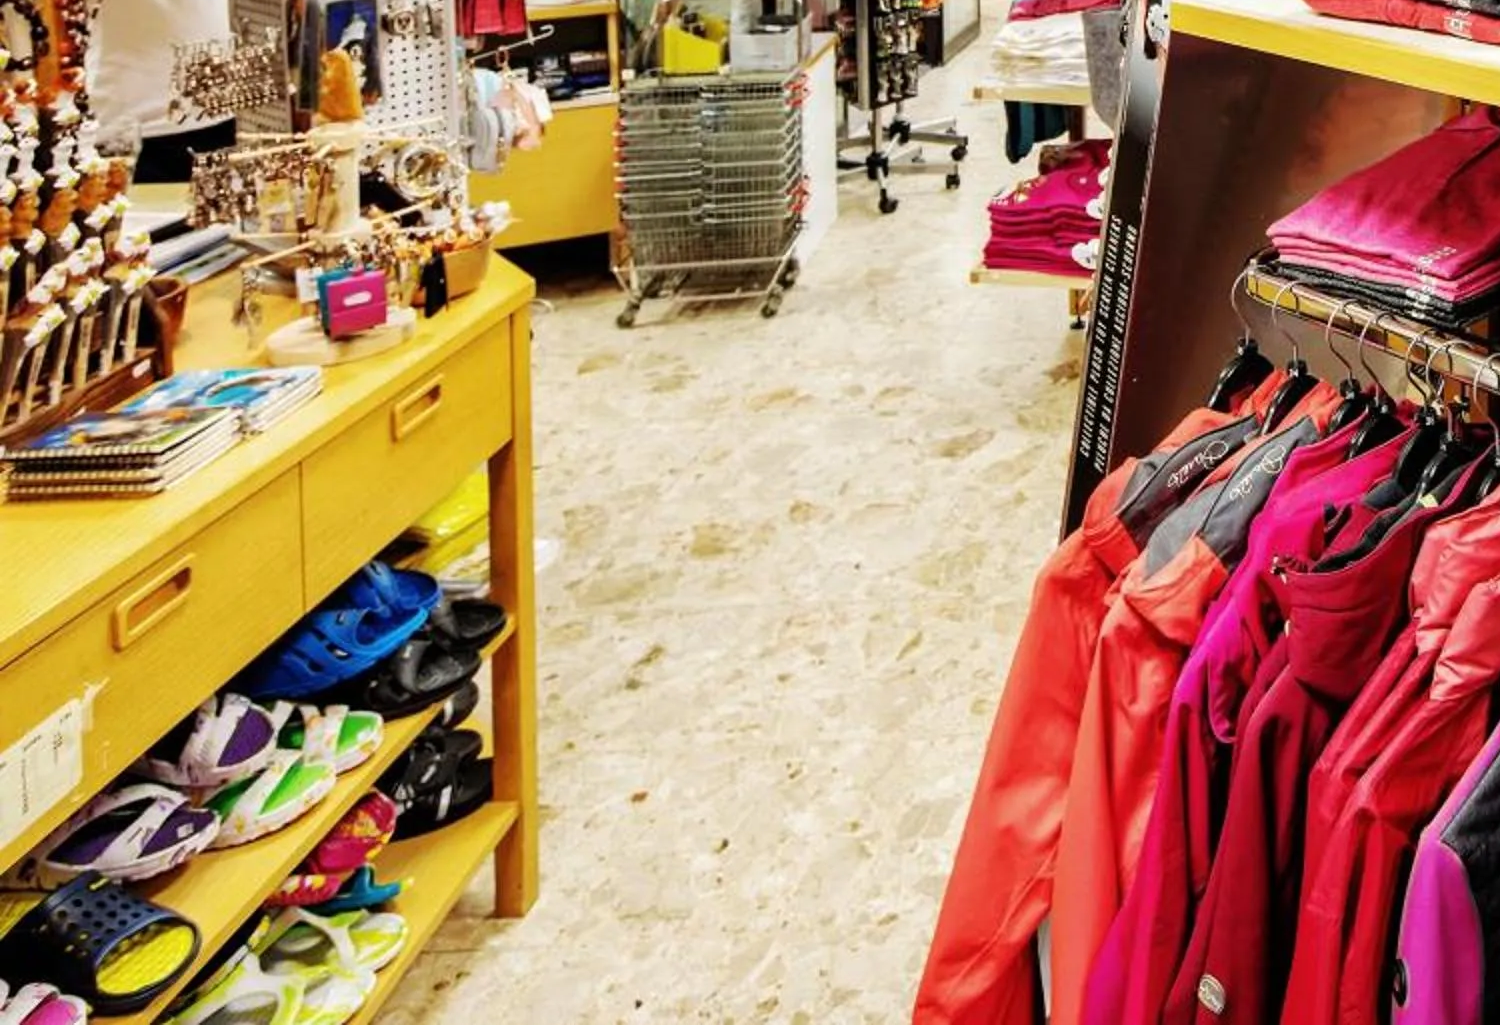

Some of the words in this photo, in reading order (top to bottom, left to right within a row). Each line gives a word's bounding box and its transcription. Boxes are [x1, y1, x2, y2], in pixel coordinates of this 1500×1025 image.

[1105, 214, 1123, 273] CLEANERS
[1099, 274, 1114, 319] SCREEN
[1095, 320, 1107, 343] TOY
